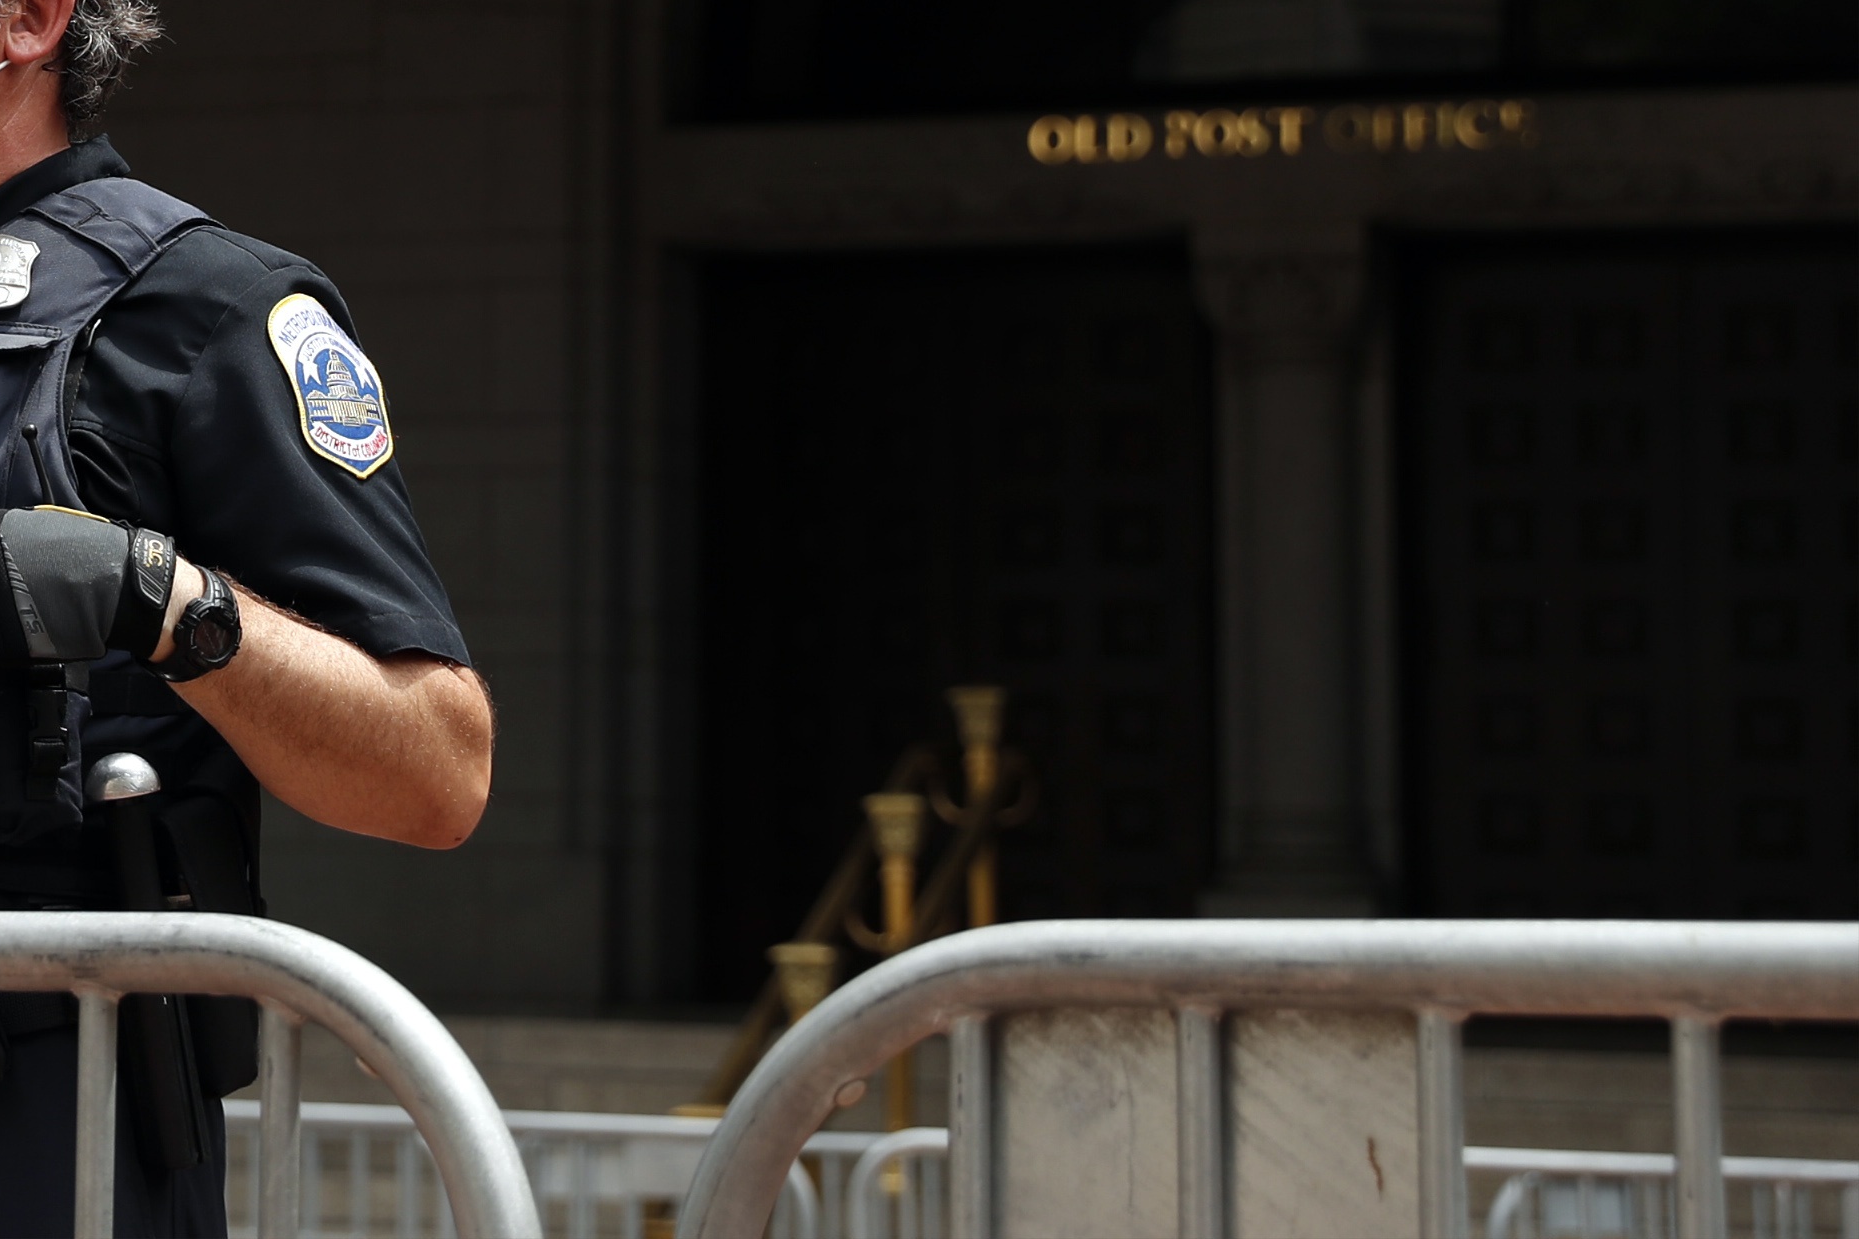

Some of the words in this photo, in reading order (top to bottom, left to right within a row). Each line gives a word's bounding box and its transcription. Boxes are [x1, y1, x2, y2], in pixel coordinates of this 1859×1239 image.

[1027, 113, 1153, 165] OLD
[1164, 106, 1315, 159] POST
[315, 427, 352, 456] DISTRICT
